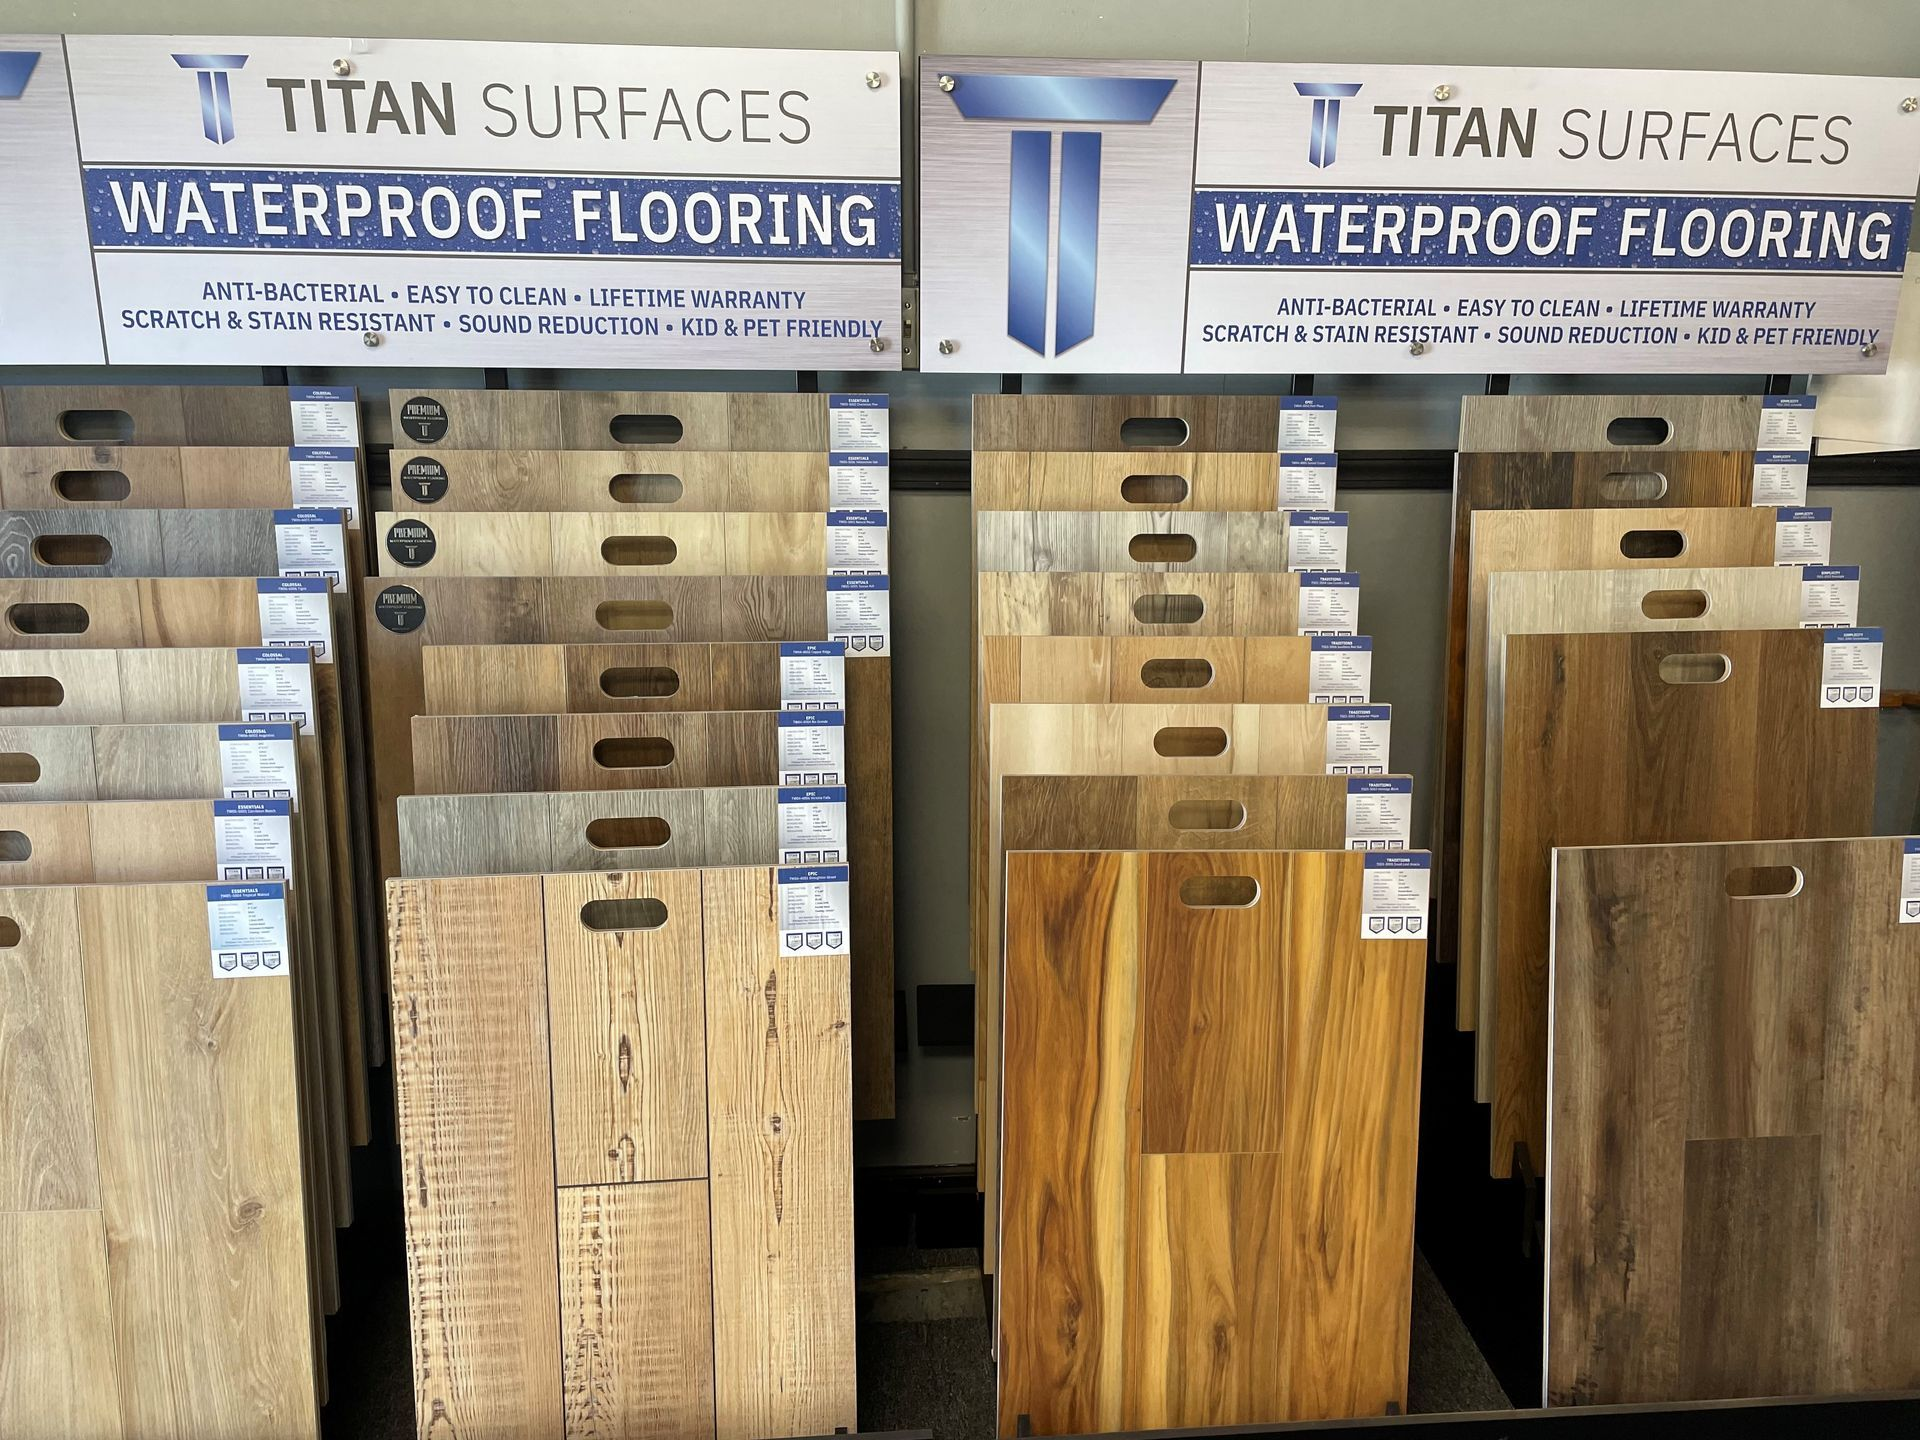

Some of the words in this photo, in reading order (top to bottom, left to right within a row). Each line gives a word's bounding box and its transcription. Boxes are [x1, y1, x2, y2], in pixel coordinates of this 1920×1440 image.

[266, 78, 457, 136] TITAN
[482, 83, 811, 145] SURFACES
[1373, 105, 1538, 158] TITAN
[1558, 108, 1852, 165] SURFACES
[109, 181, 542, 240] WATERPROOF
[572, 190, 876, 248] FLOORING
[1215, 203, 1598, 256] WATERPROOF
[1619, 207, 1892, 260] FLOORING
[202, 282, 385, 304] ANTI-BACTERIAL
[408, 285, 461, 304] EASY
[465, 286, 494, 305] TO
[499, 286, 567, 306] CLEAN
[589, 288, 684, 307] LIFETIME
[690, 289, 806, 310] WARRANTY
[1276, 297, 1437, 317] ANTI-BACTERIAL
[1457, 298, 1507, 317] EASY
[1510, 299, 1535, 317] TO
[1539, 299, 1601, 318] CLEAN
[1619, 299, 1707, 319] LIFETIME
[1712, 300, 1817, 319] WARRANTY
[121, 309, 221, 330] SCRATCH
[227, 311, 243, 330] &
[247, 311, 313, 331] STAIN
[318, 312, 436, 333] RESISTANT
[458, 314, 532, 334] SOUND
[538, 315, 659, 336] REDUCTION
[681, 317, 718, 337] KID
[724, 318, 739, 337] &
[743, 318, 781, 338] PET
[786, 319, 883, 339] FRIENDLY
[1202, 324, 1289, 343] SCRATCH
[1294, 325, 1308, 343] &
[1312, 325, 1370, 343] STAIN
[1374, 325, 1479, 344] RESISTANT
[1497, 325, 1564, 344] SOUND
[1568, 326, 1678, 345] REDUCTION
[1697, 326, 1732, 345] KID
[1735, 327, 1750, 345] &
[1753, 327, 1789, 345] PET
[1791, 327, 1879, 347] FRIENDLY
[407, 404, 440, 416] PREMIUM
[407, 464, 441, 476] PREMIUM
[393, 527, 428, 538] PREMIUM
[382, 593, 418, 604] PREMIUM
